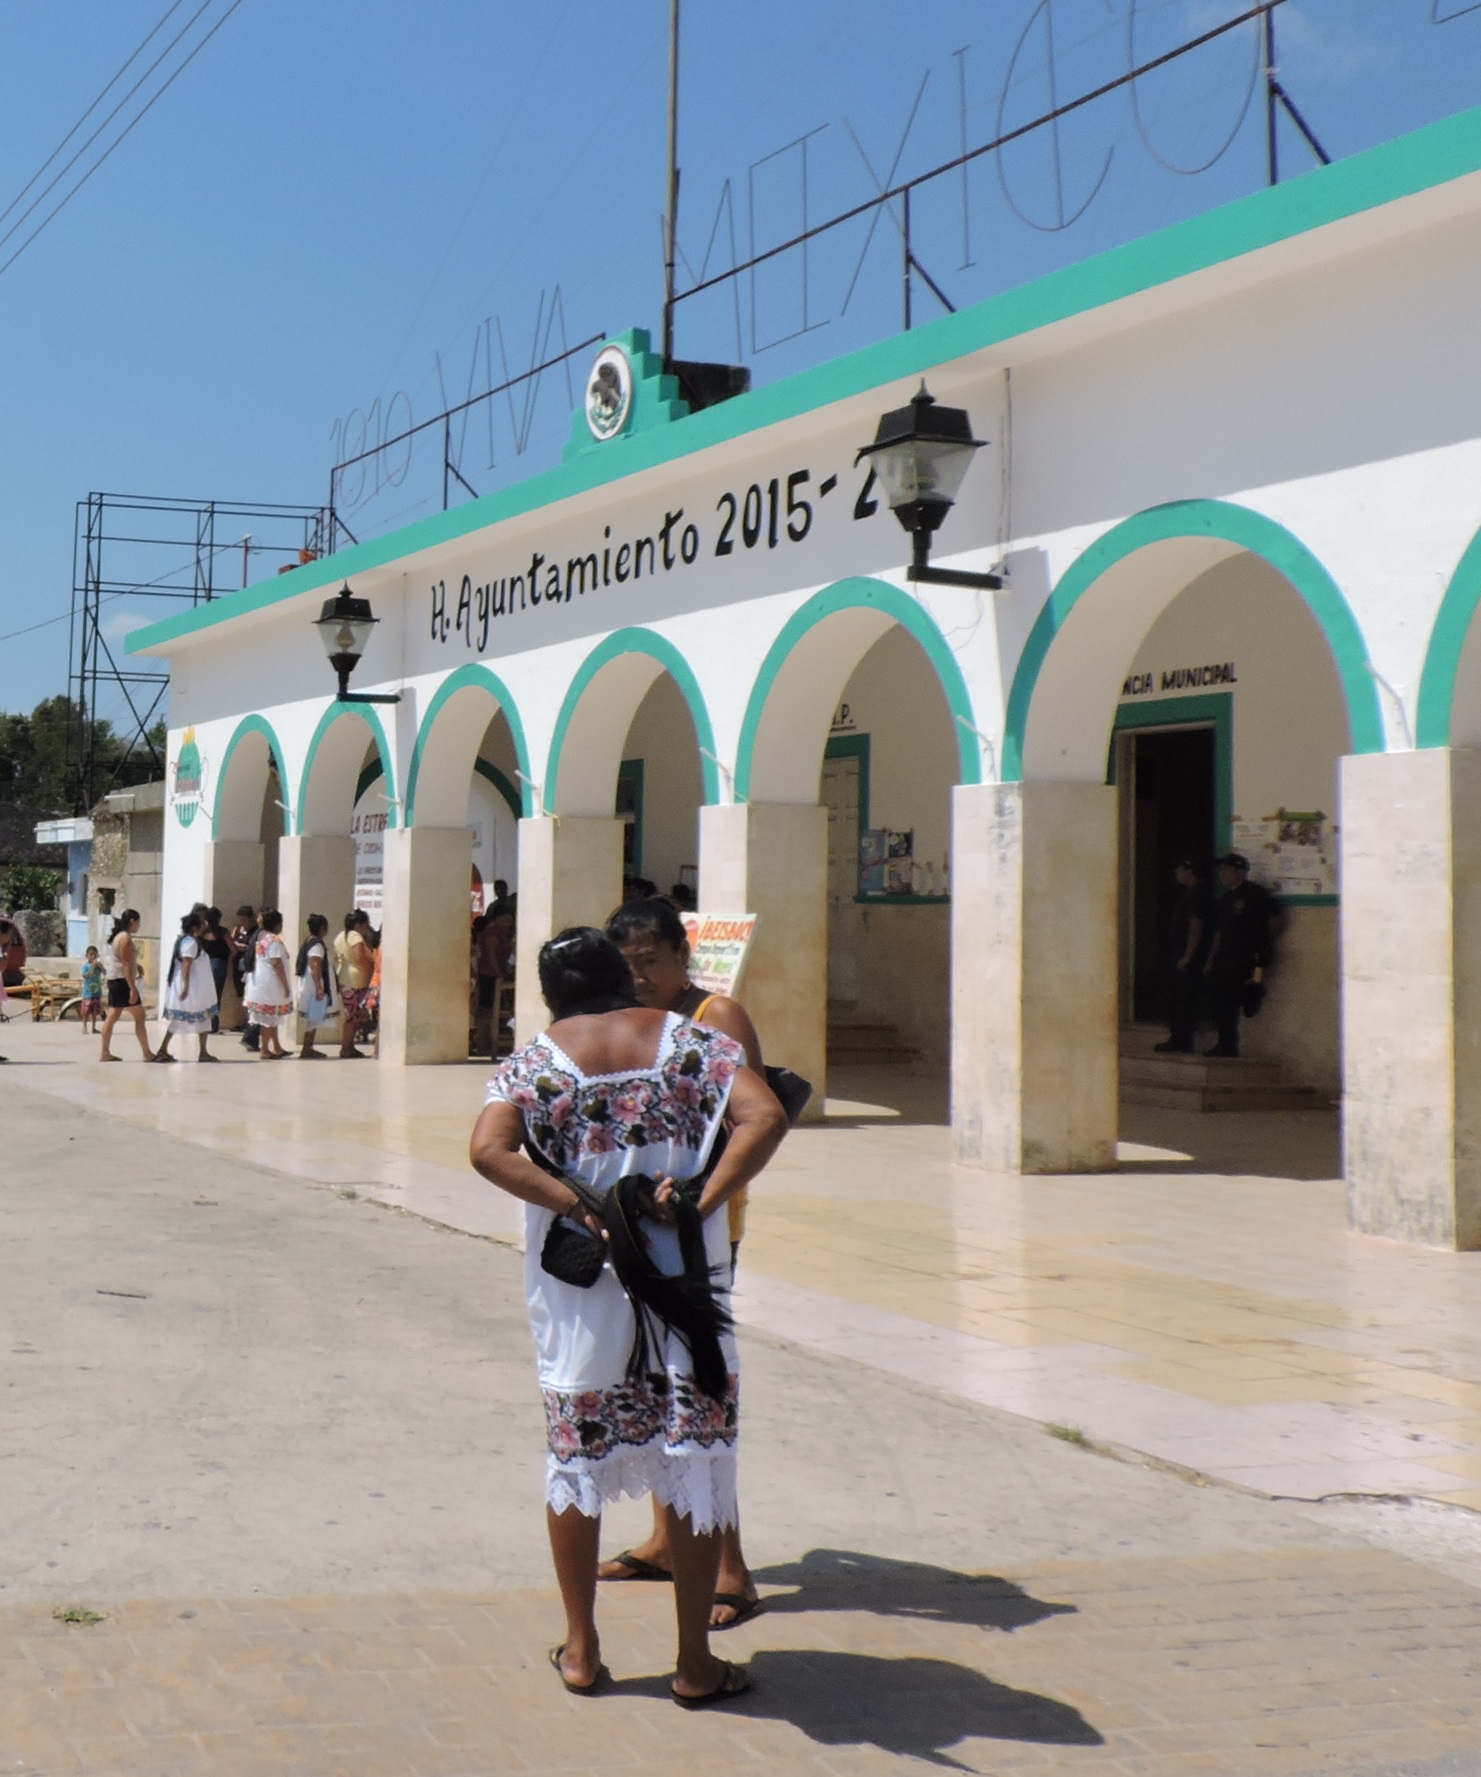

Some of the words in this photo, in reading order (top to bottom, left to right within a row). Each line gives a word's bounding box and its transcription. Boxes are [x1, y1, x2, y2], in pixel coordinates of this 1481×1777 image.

[431, 579, 451, 644] H.
[456, 507, 700, 653] Ayuntamiento
[1161, 661, 1238, 691] MUNICIPAL
